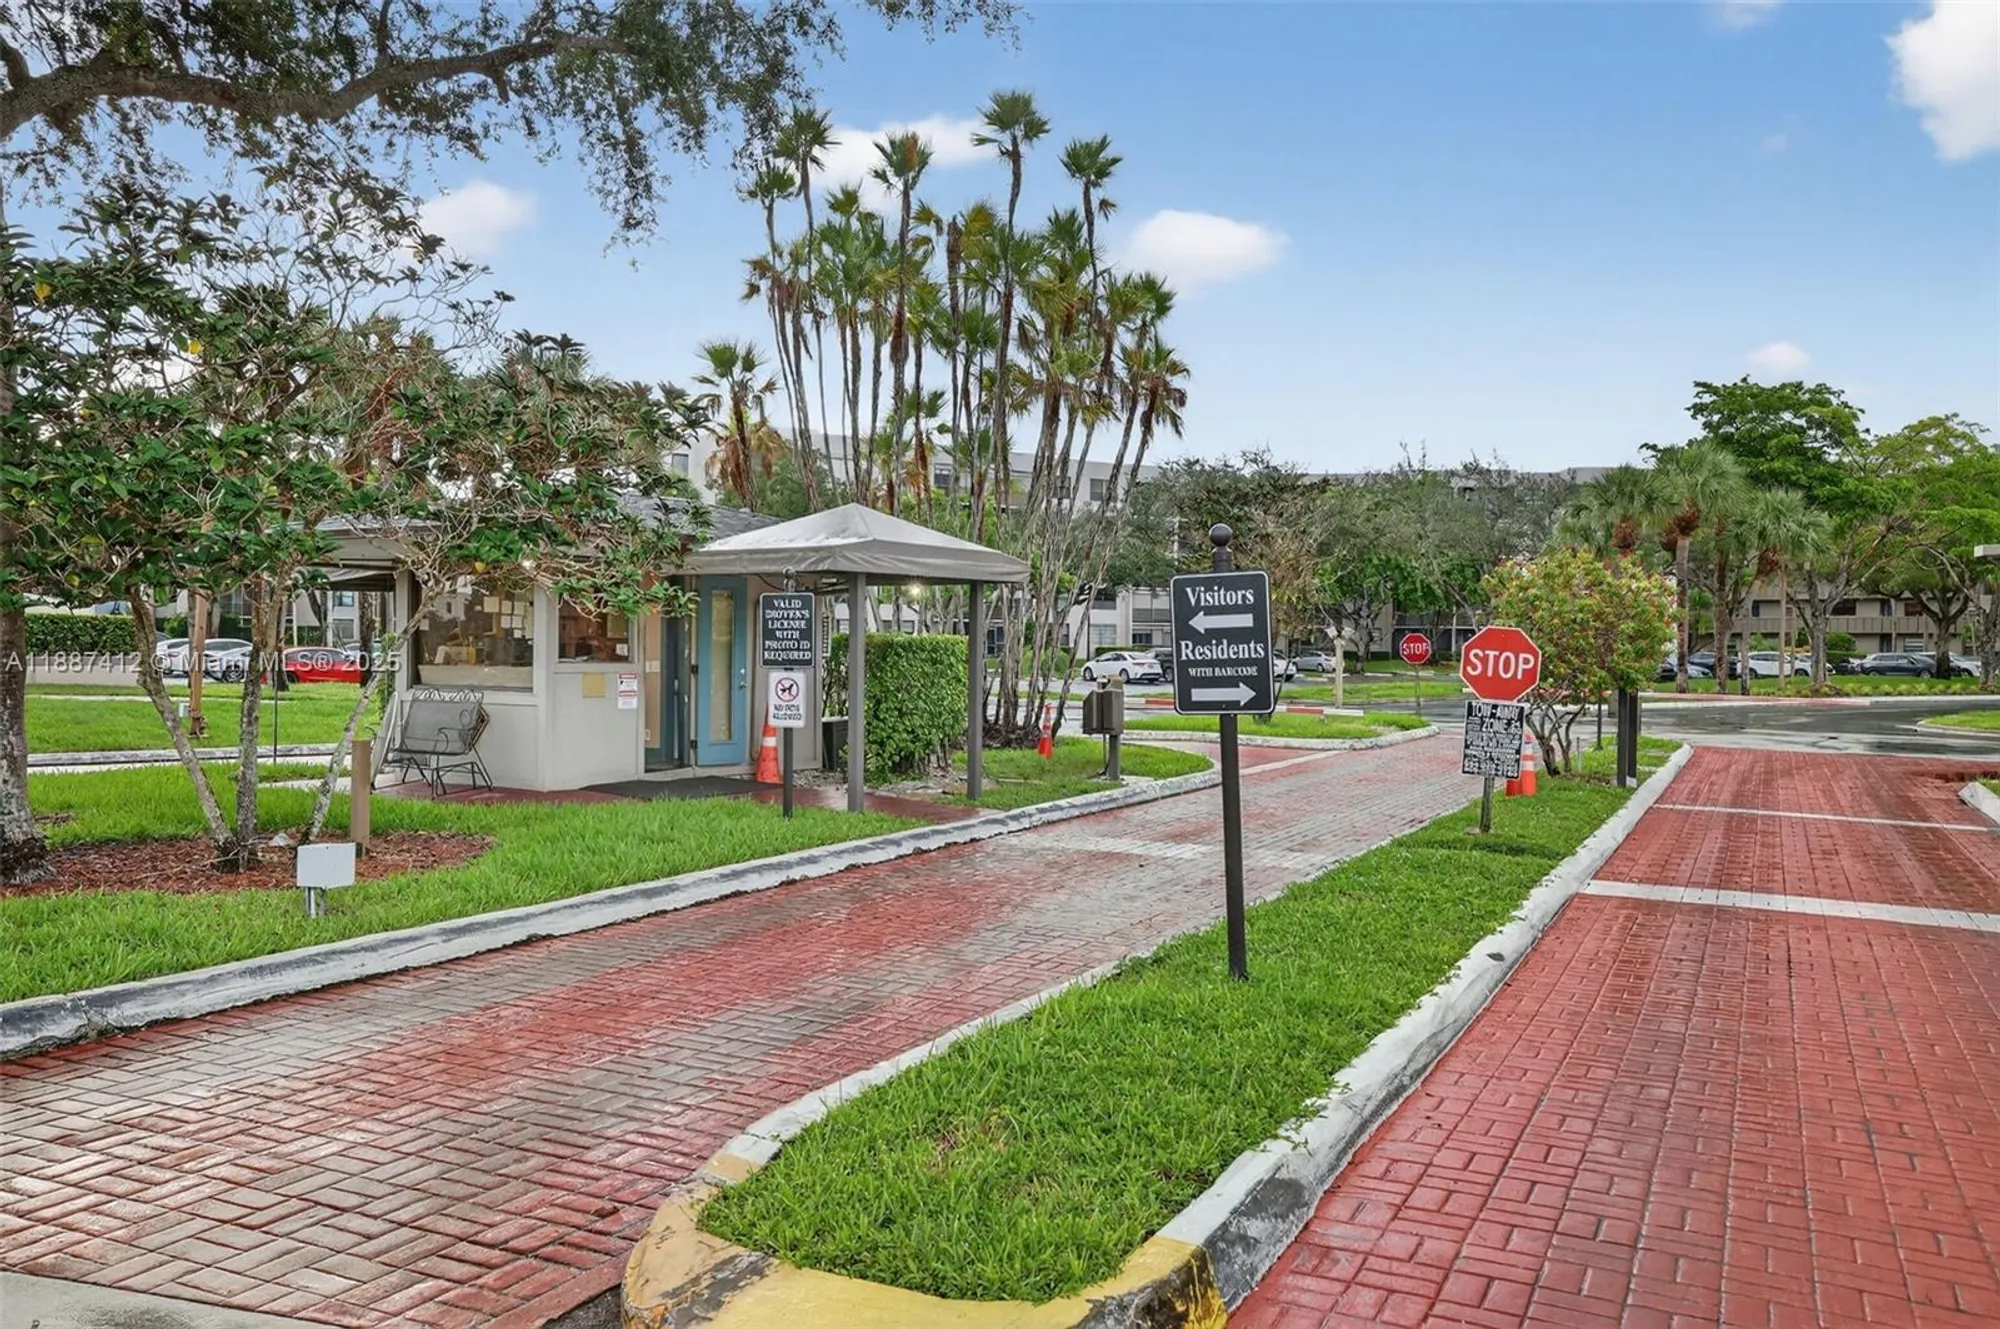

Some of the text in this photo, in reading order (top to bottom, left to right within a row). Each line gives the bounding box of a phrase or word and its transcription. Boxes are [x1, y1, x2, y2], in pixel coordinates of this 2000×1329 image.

[1186, 586, 1254, 606] Visitors
[773, 599, 802, 608] VALID
[775, 630, 800, 639] WITH
[1180, 639, 1265, 660] Residents
[1403, 642, 1429, 655] STOP
[1466, 649, 1535, 680] STOP
[1188, 667, 1213, 677] WITH
